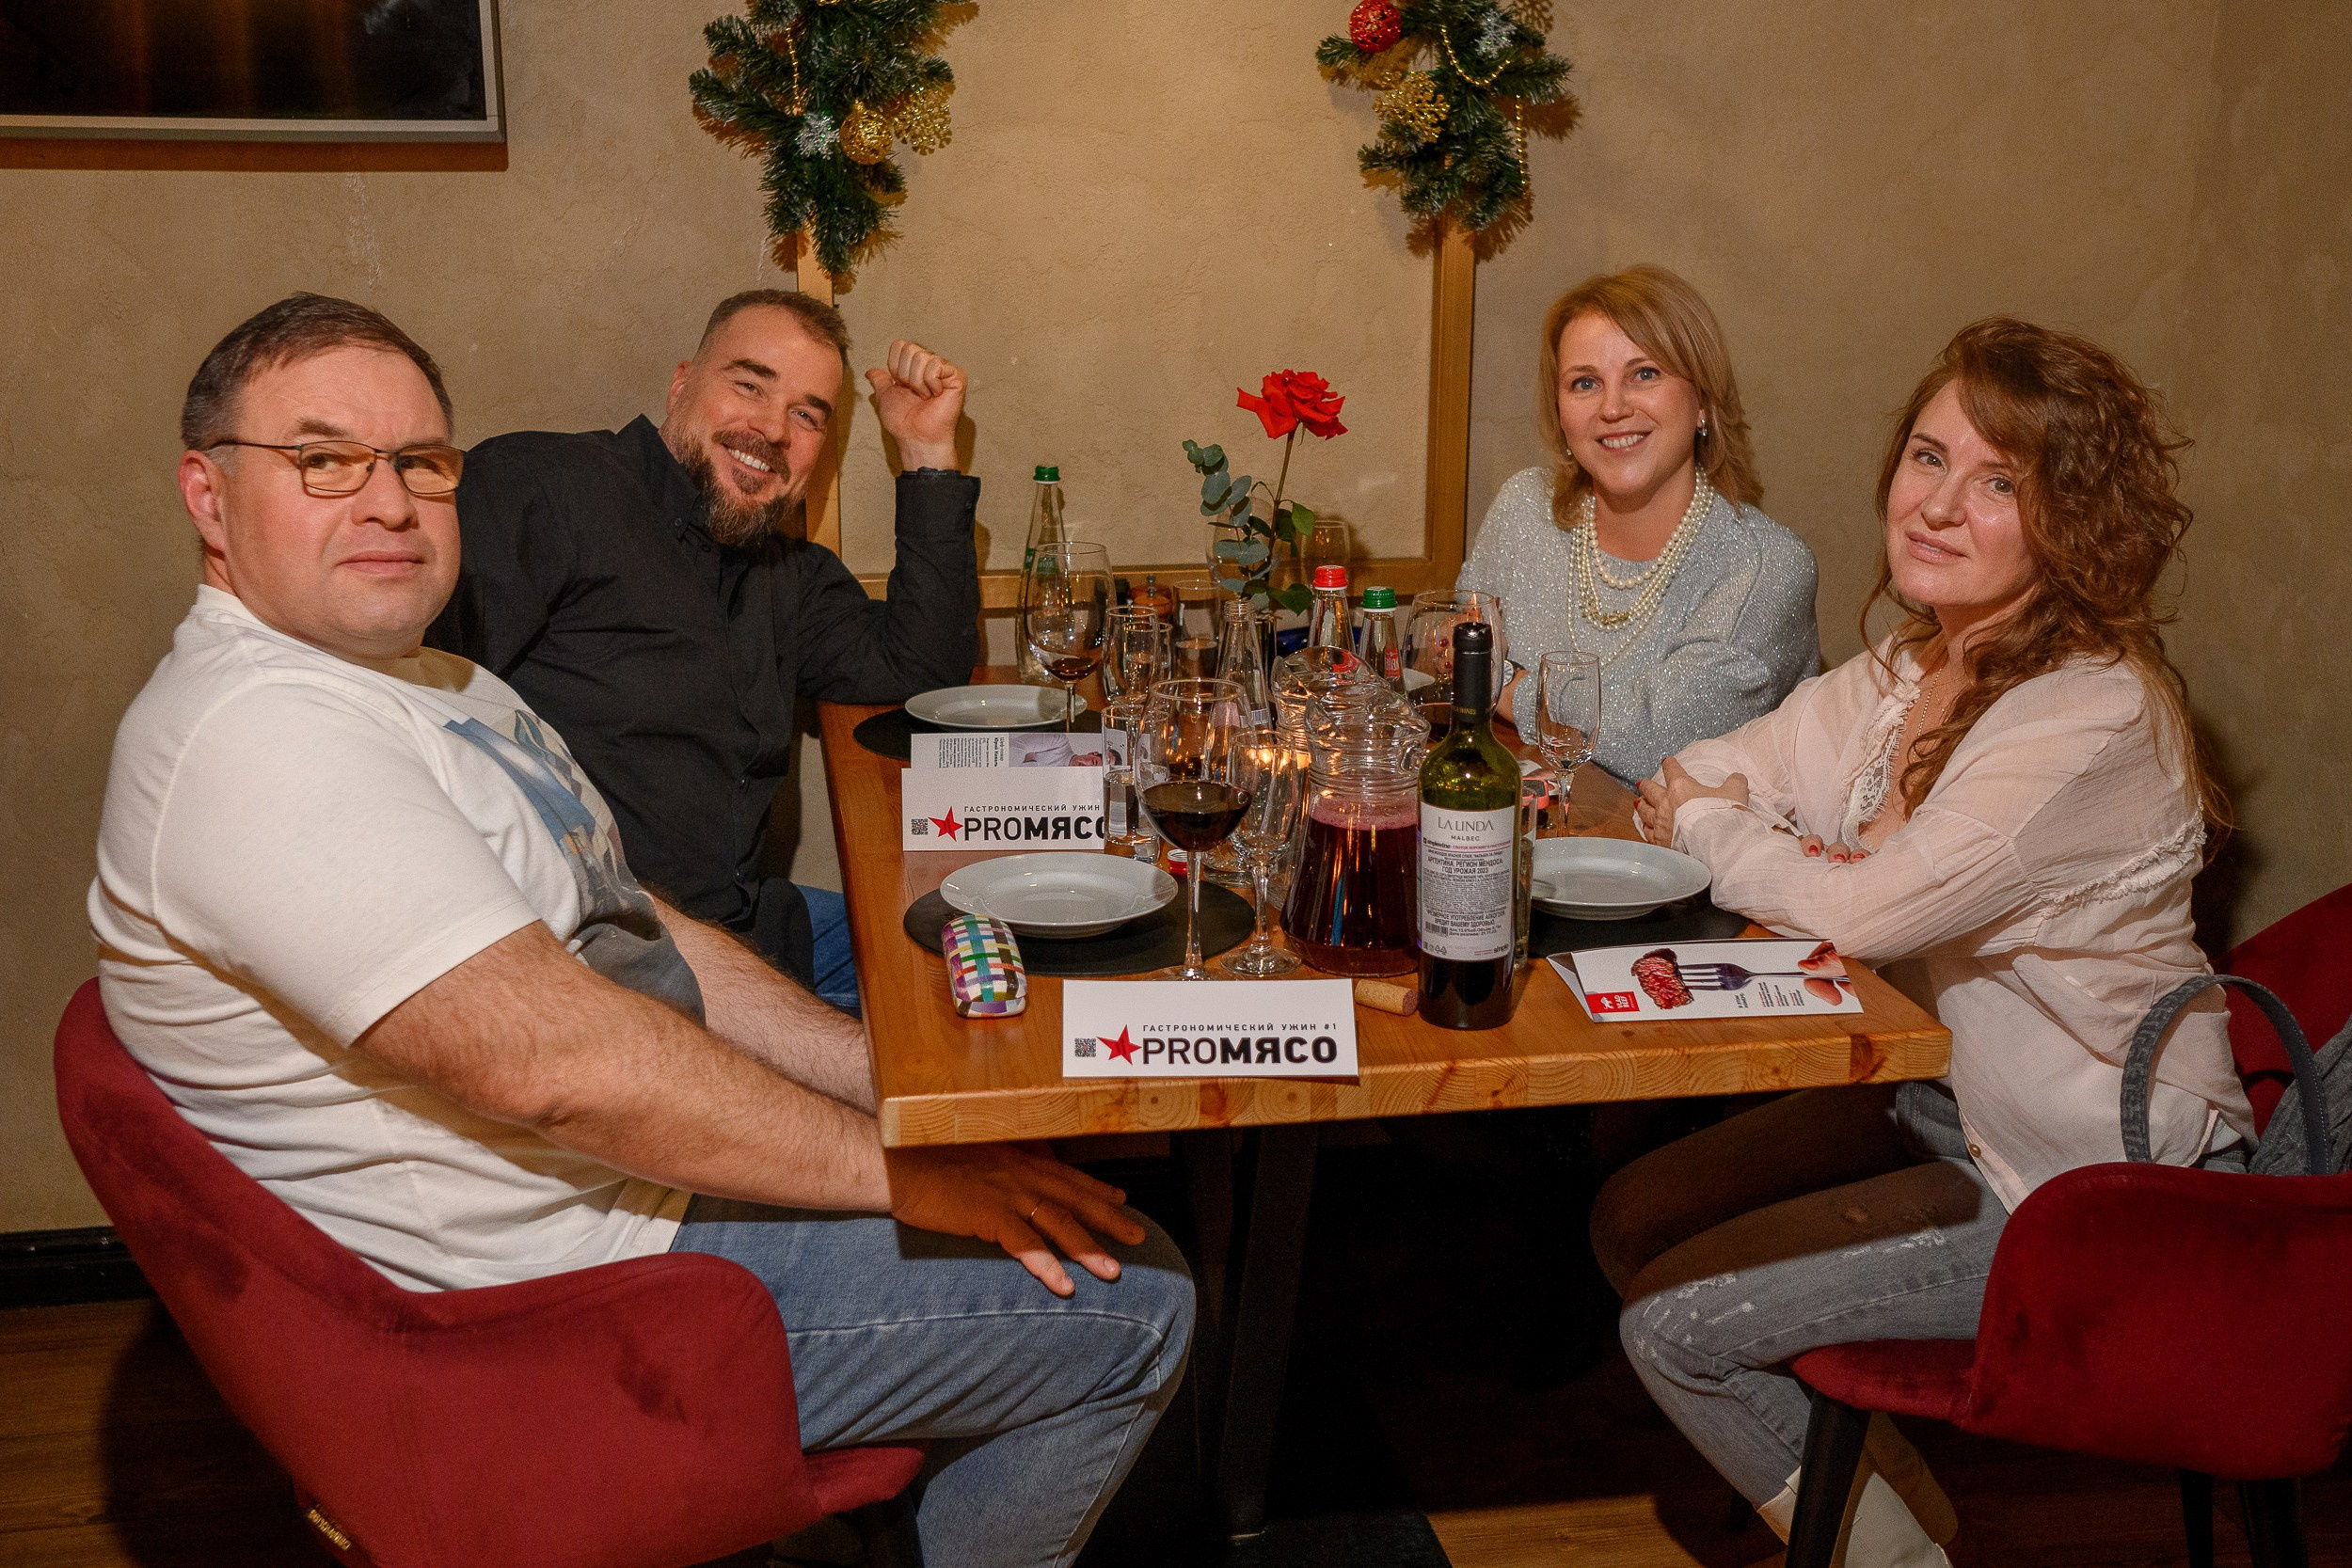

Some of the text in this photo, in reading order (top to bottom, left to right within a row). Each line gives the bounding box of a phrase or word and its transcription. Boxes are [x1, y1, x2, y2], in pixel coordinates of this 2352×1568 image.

[964, 804, 1067, 813] ГАСТРОНОМИЧЕСКИЙ
[1438, 816, 1494, 832] LA LINDA
[1441, 865, 1453, 874] ГОД
[1434, 918, 1450, 927] ВРЕДИТ
[1142, 1022, 1274, 1032] ГАСТРОНОМИЧЕСКИЙ
[1324, 1022, 1337, 1031] #1
